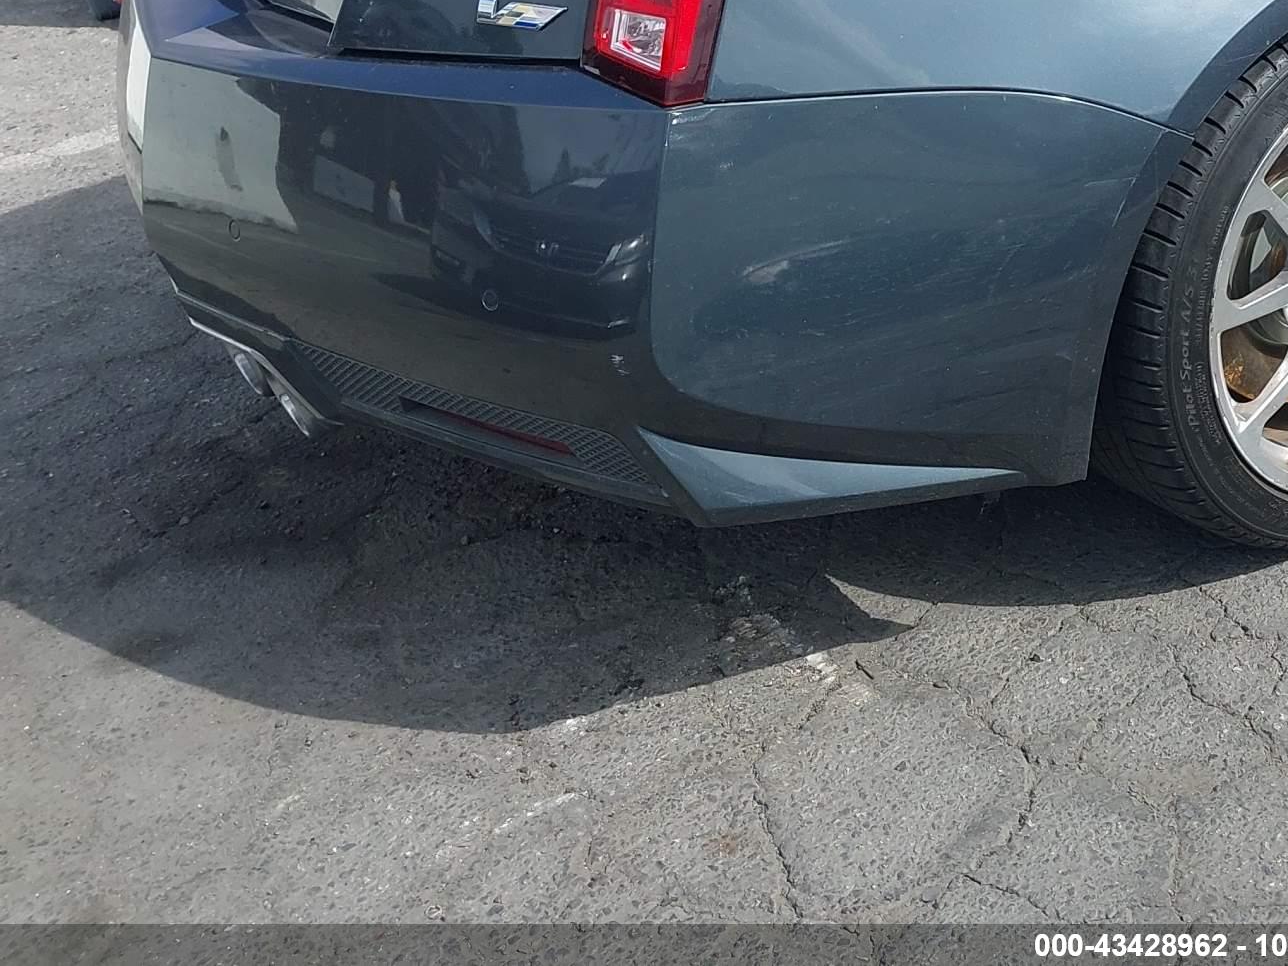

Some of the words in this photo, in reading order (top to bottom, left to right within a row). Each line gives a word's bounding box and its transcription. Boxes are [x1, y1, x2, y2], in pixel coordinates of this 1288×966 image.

[1181, 288, 1194, 322] A/S
[1180, 330, 1191, 381] Sport
[1181, 388, 1200, 427] Pilot
